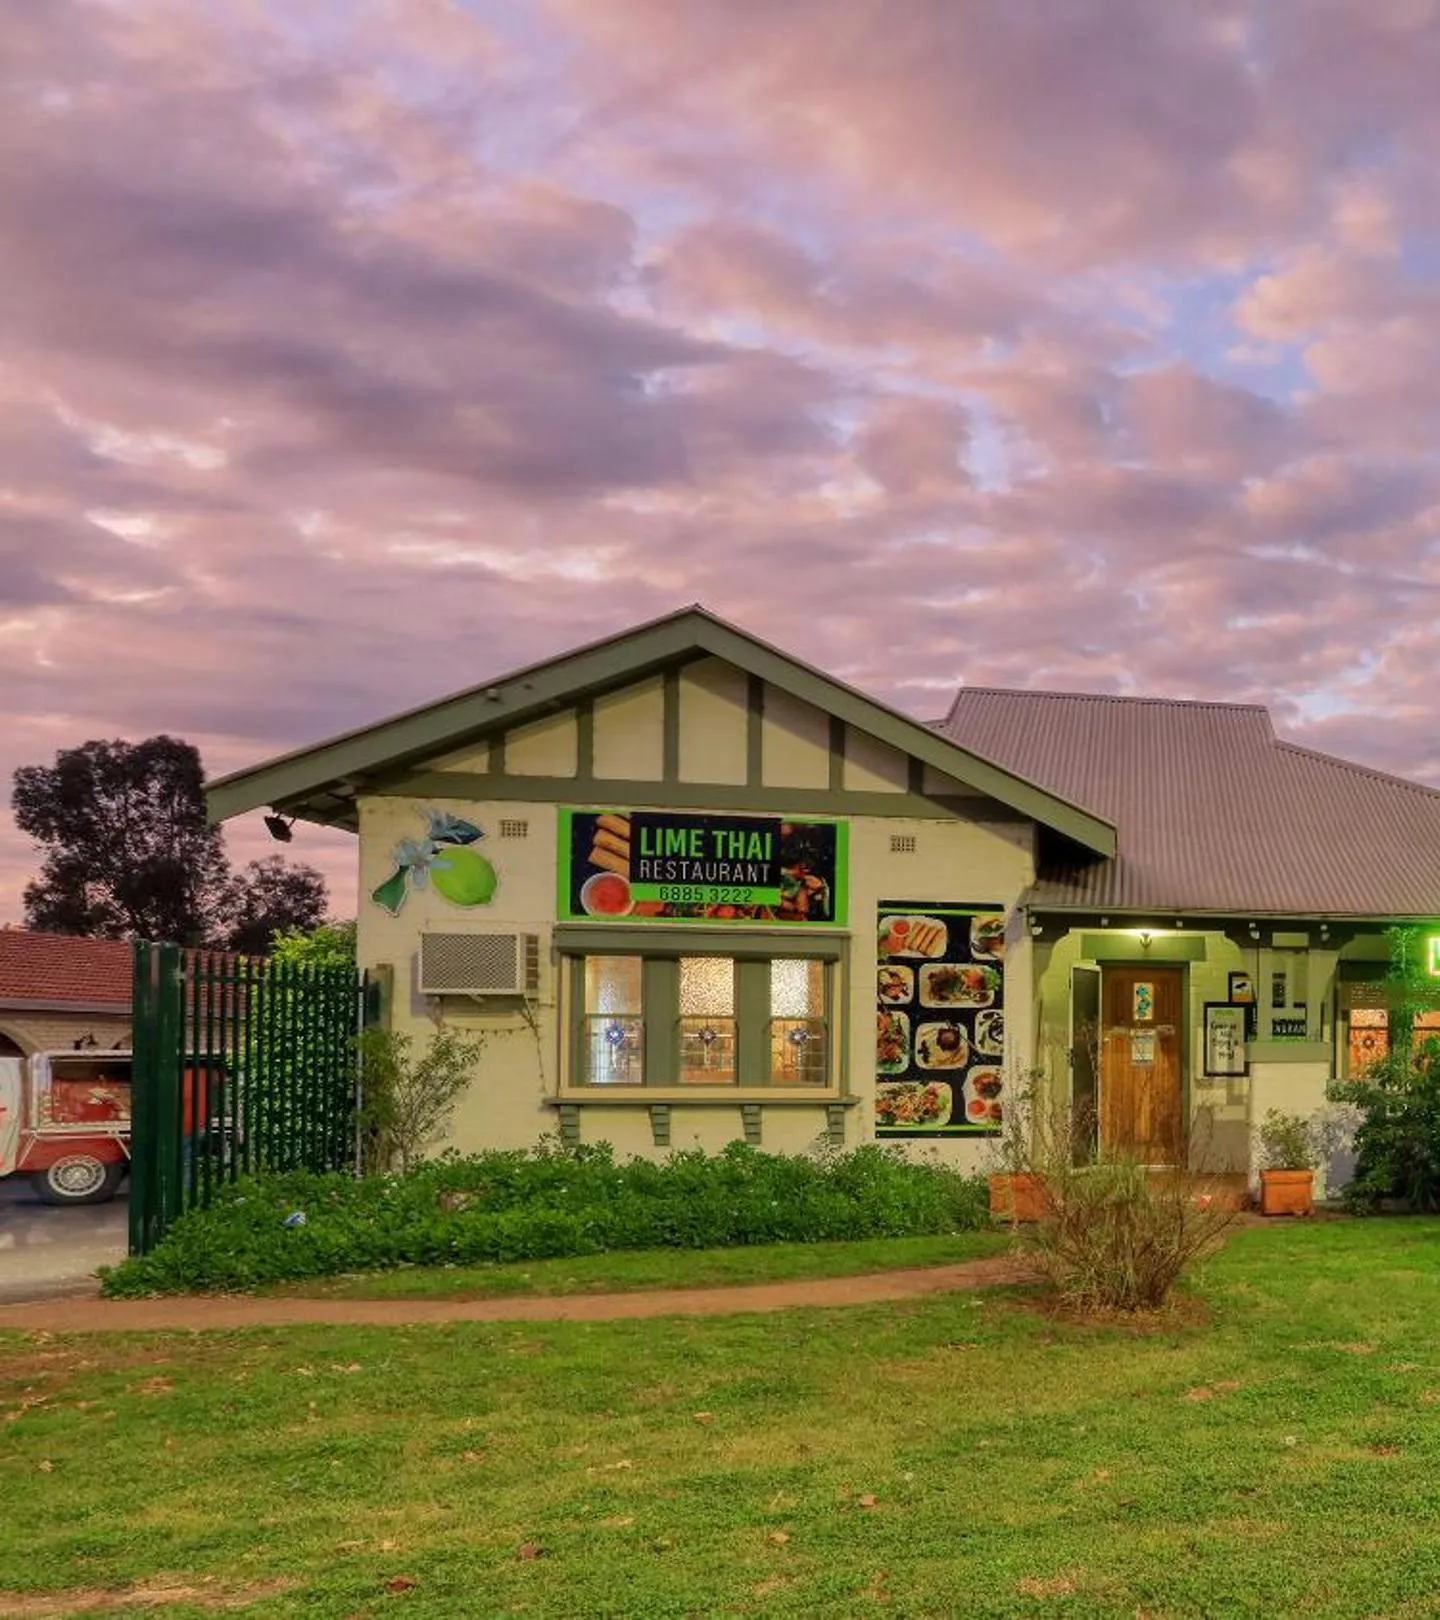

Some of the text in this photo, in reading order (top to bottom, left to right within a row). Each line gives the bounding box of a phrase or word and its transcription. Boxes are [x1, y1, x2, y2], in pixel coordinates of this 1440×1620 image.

[639, 827, 773, 861] LIME THAI
[639, 859, 770, 884] RESTAURANT
[659, 886, 753, 903] 6885 3222
